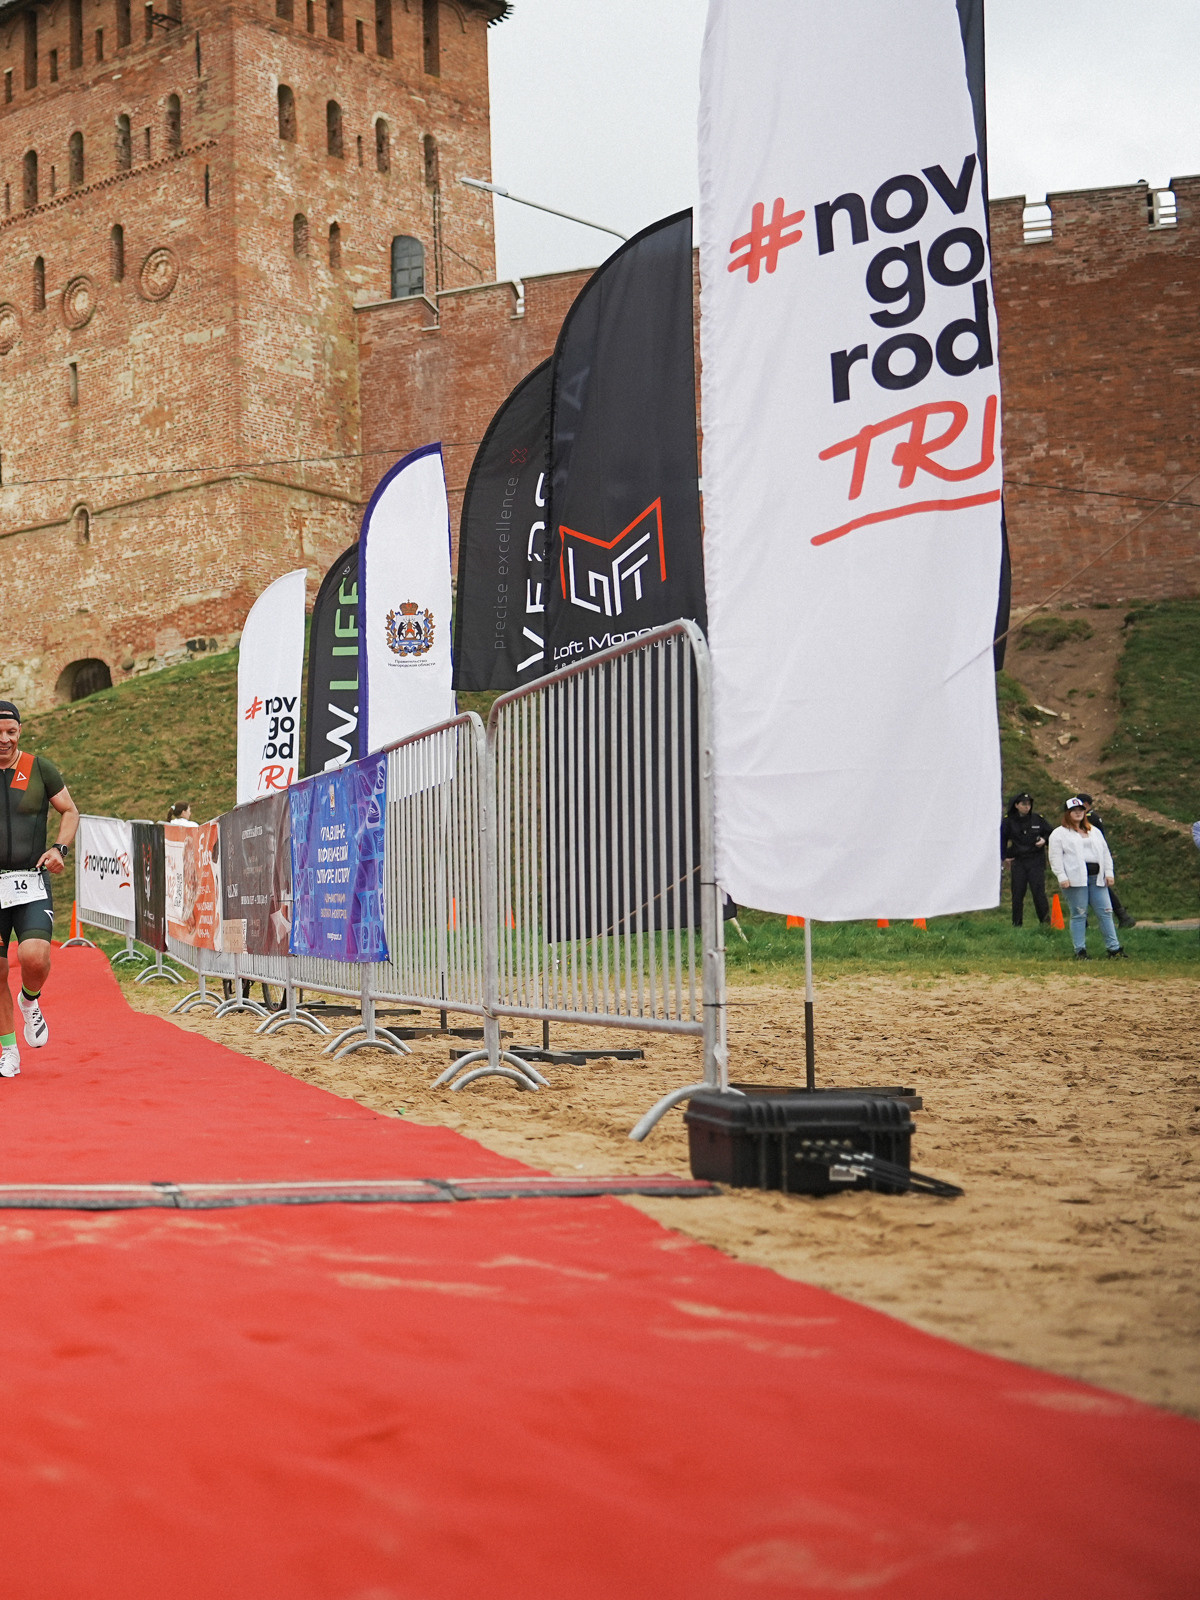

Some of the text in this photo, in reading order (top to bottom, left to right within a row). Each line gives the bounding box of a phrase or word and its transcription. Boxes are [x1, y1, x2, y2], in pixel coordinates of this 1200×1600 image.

[727, 152, 977, 284] #nov
[865, 226, 986, 329] go
[830, 278, 994, 404] rod
[818, 394, 998, 502] TRI
[493, 476, 519, 650] precise excellence
[553, 641, 584, 661] Loft
[268, 716, 295, 740] go
[14, 880, 28, 891] 16
